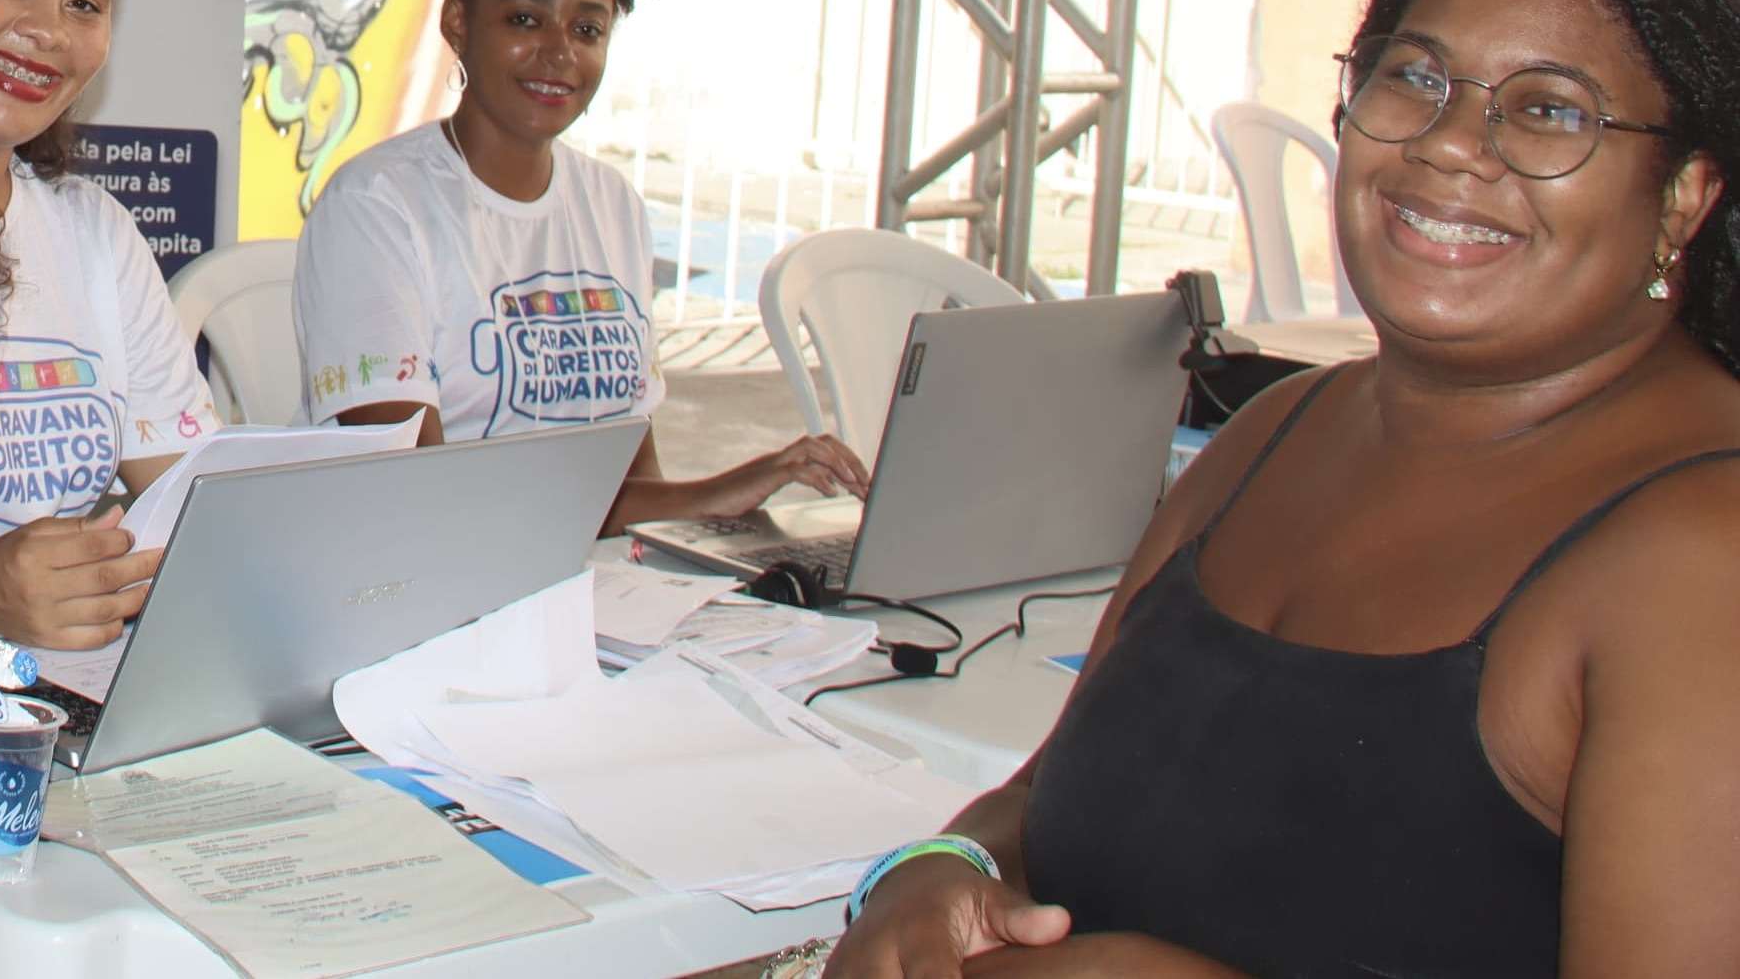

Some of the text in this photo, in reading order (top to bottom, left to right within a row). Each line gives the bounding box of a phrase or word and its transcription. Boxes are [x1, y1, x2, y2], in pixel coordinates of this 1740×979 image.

[105, 141, 153, 164] pela
[160, 142, 192, 163] Lei
[516, 324, 632, 359] CARAVANA
[543, 350, 639, 376] DIREITOS
